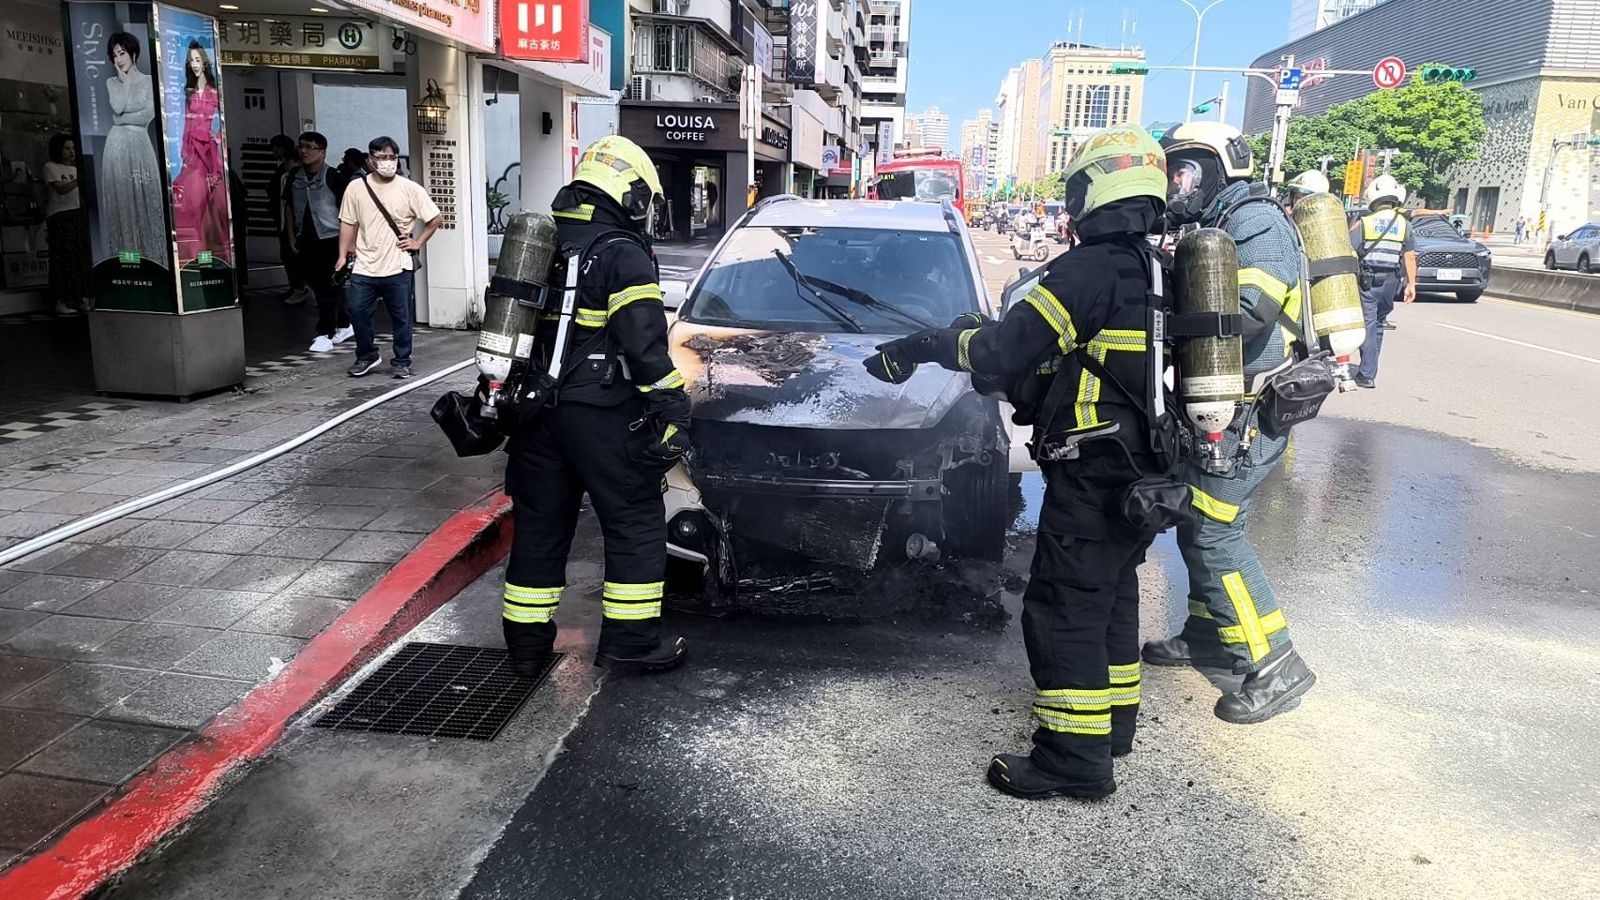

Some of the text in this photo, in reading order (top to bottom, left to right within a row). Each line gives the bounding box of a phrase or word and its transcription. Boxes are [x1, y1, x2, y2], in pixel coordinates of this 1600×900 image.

[791, 3, 815, 17] 101
[76, 21, 106, 79] Style
[517, 38, 561, 51] 麻古茶坊
[322, 57, 368, 67] PHARMACY
[1280, 69, 1291, 83] P
[1558, 94, 1587, 109] Van
[656, 114, 715, 129] LOUISA
[666, 131, 705, 141] COFFEE
